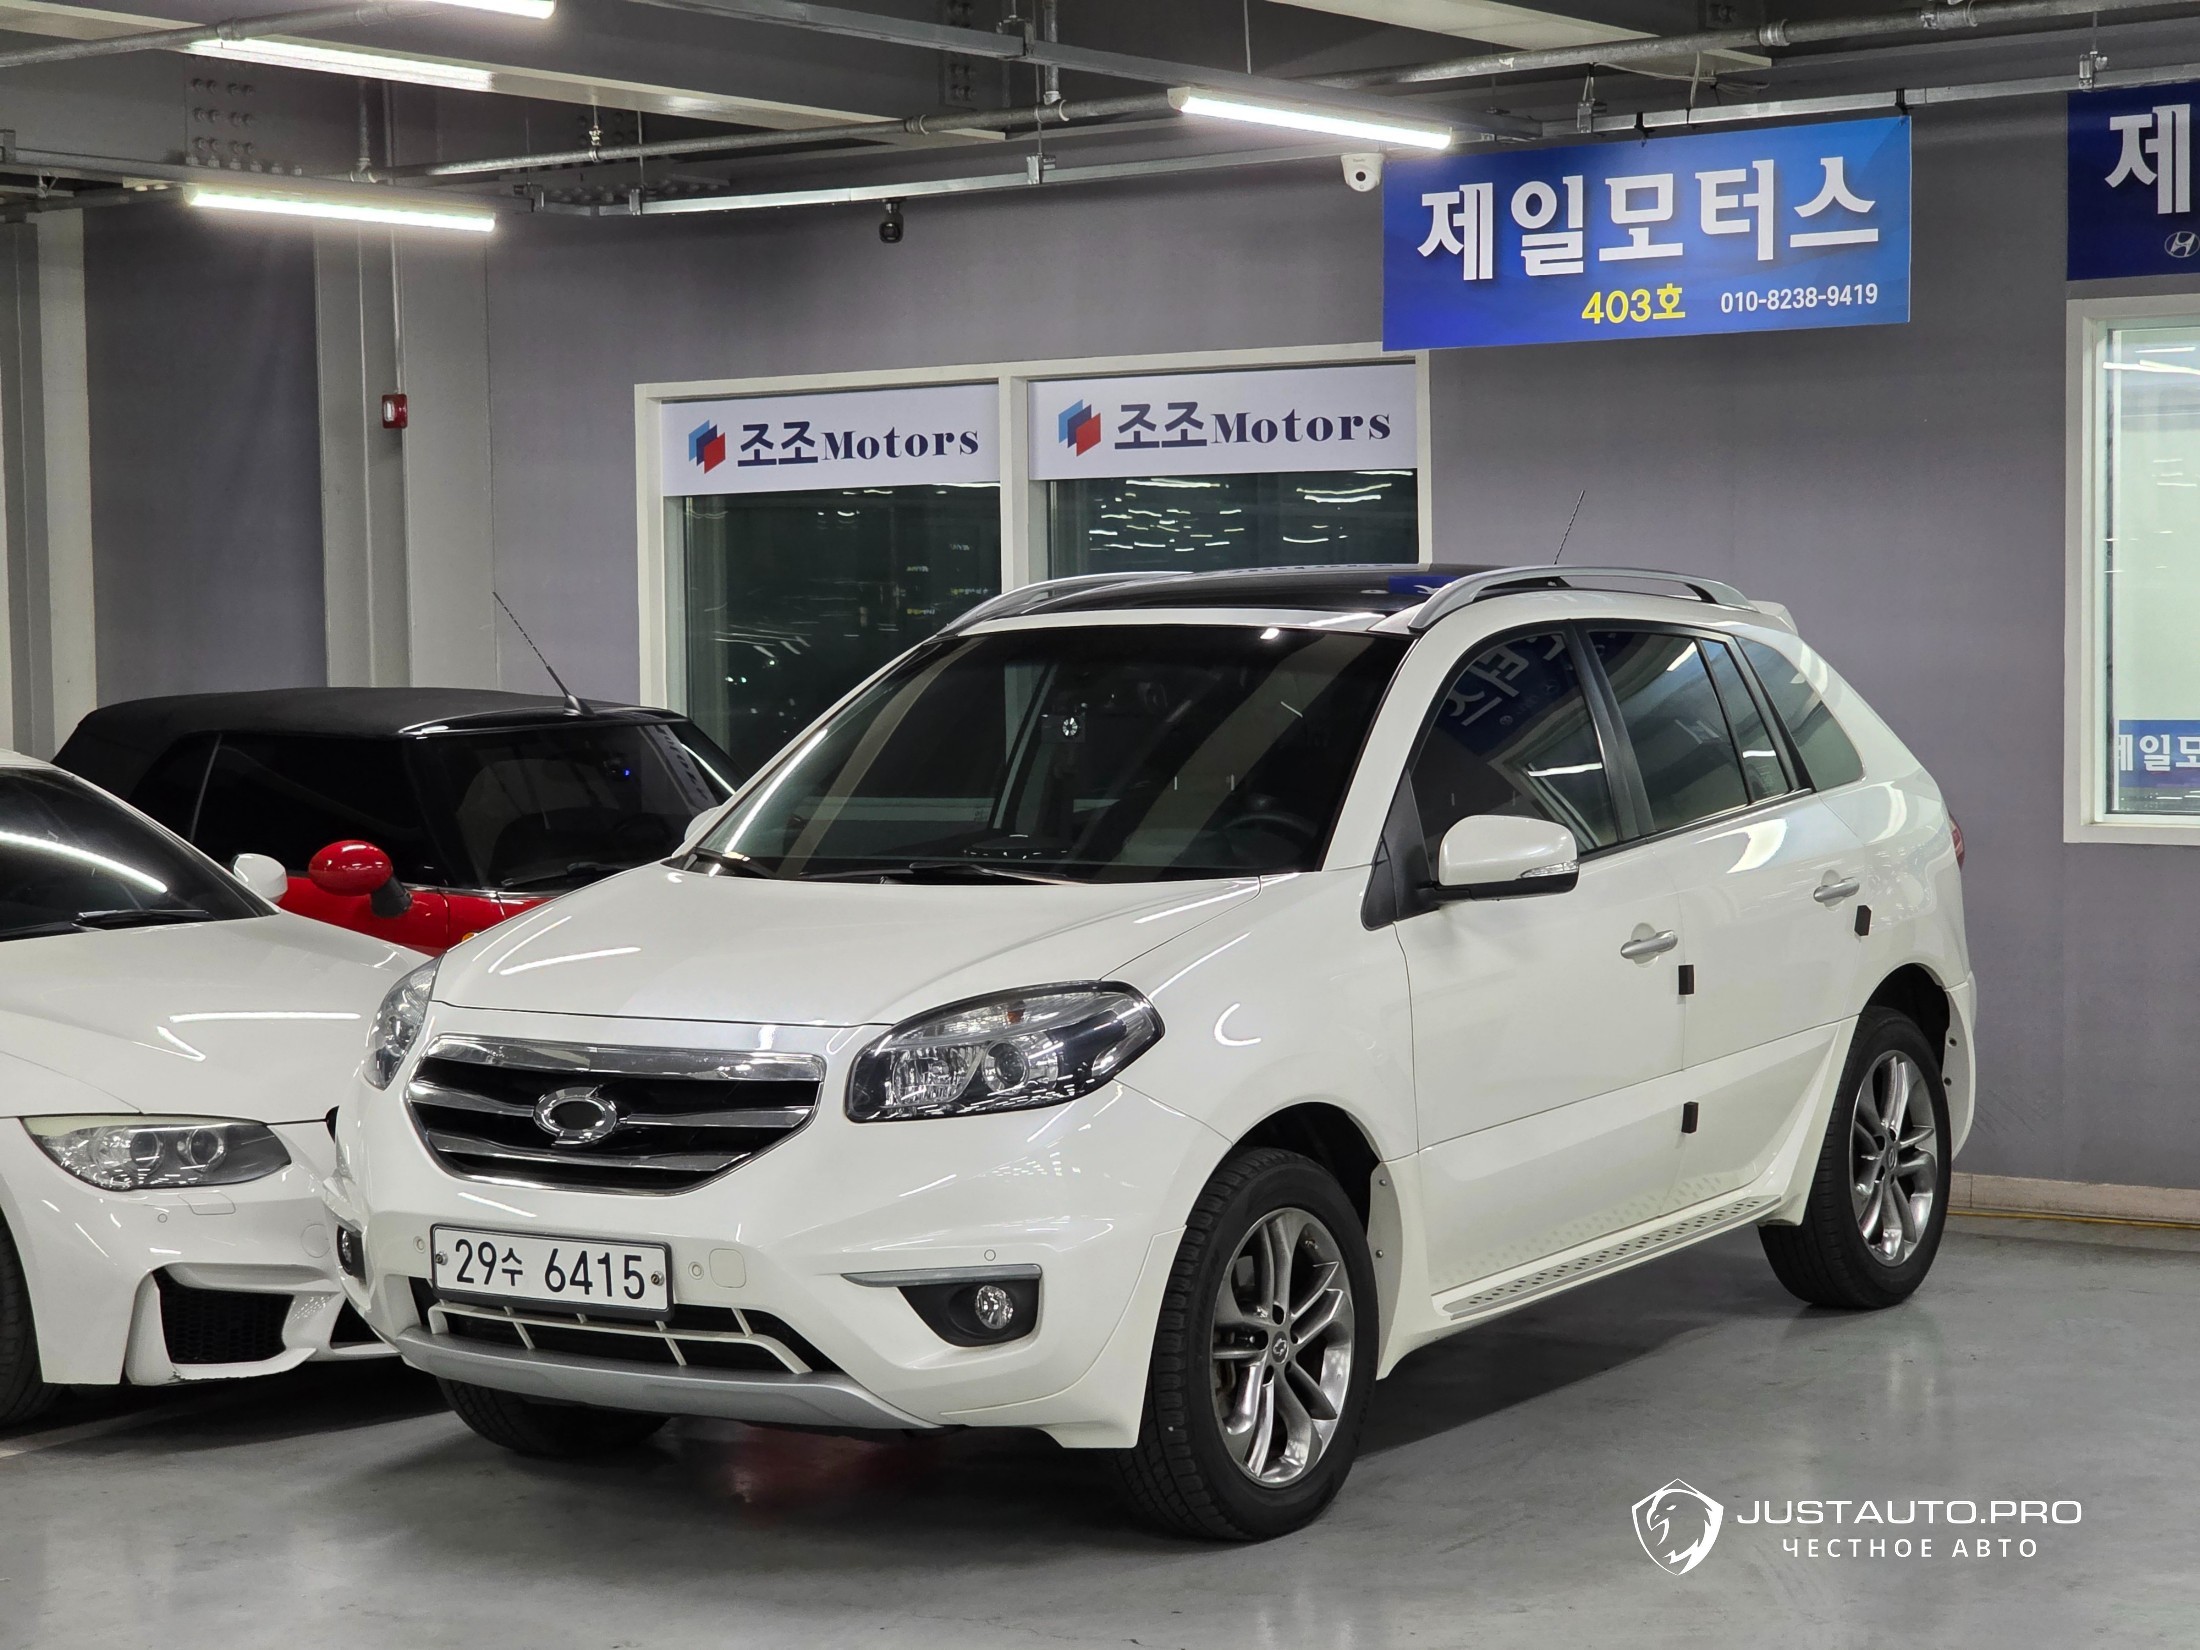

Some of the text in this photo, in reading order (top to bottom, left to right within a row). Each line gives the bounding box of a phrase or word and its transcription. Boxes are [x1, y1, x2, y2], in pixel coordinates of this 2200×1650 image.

[2104, 103, 2191, 215] 제
[1416, 156, 1879, 281] 제일모터스
[1582, 283, 1685, 323] 403호
[1720, 283, 1878, 314] 010-8238-9419
[455, 1238, 645, 1300] 29수 6415
